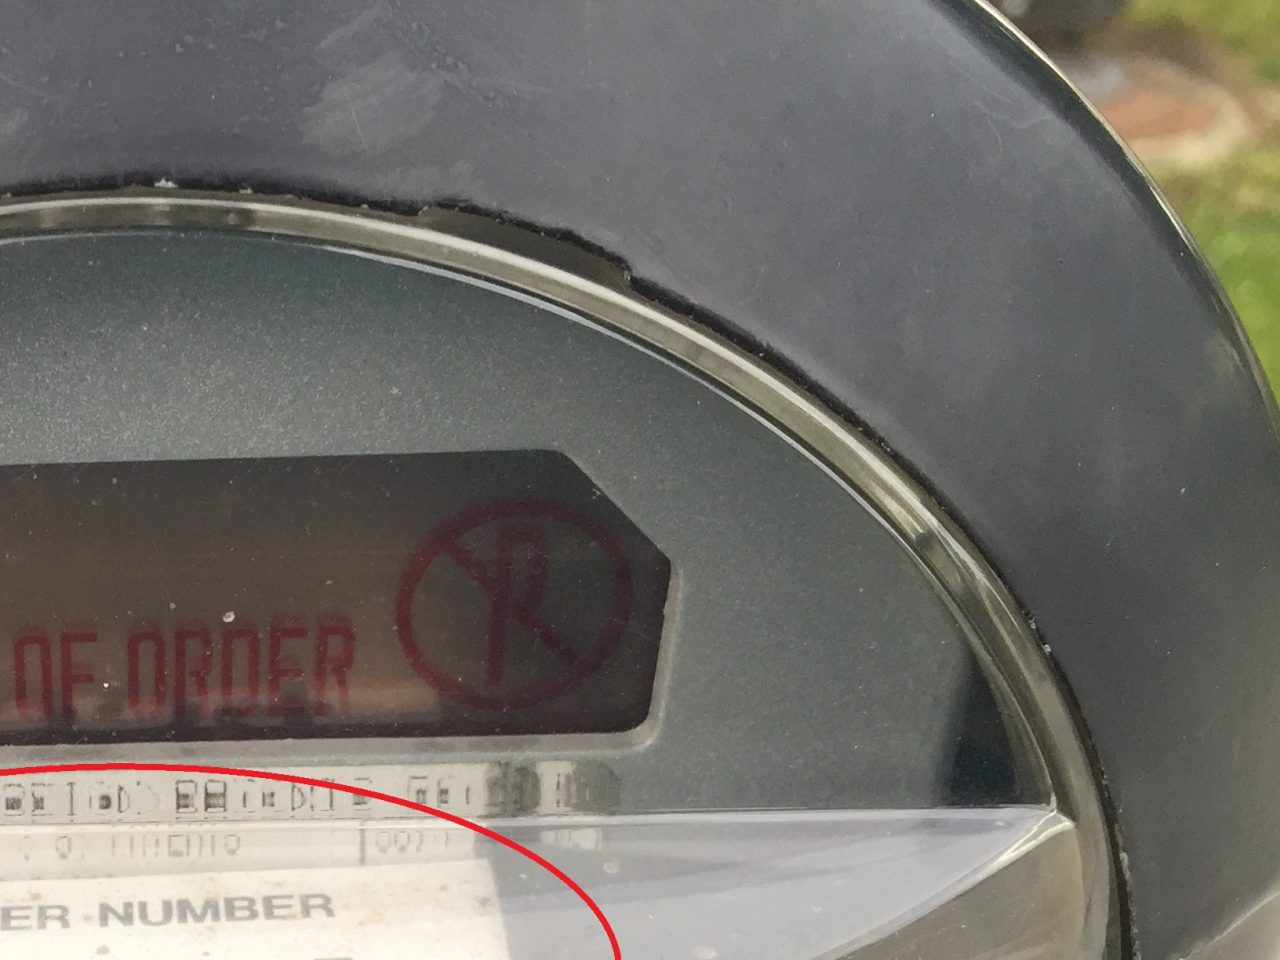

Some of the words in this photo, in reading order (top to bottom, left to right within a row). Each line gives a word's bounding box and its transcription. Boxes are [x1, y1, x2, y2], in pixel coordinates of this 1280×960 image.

[12, 625, 97, 722] OF
[127, 611, 357, 719] ORDER
[97, 892, 337, 930] NUMBER
